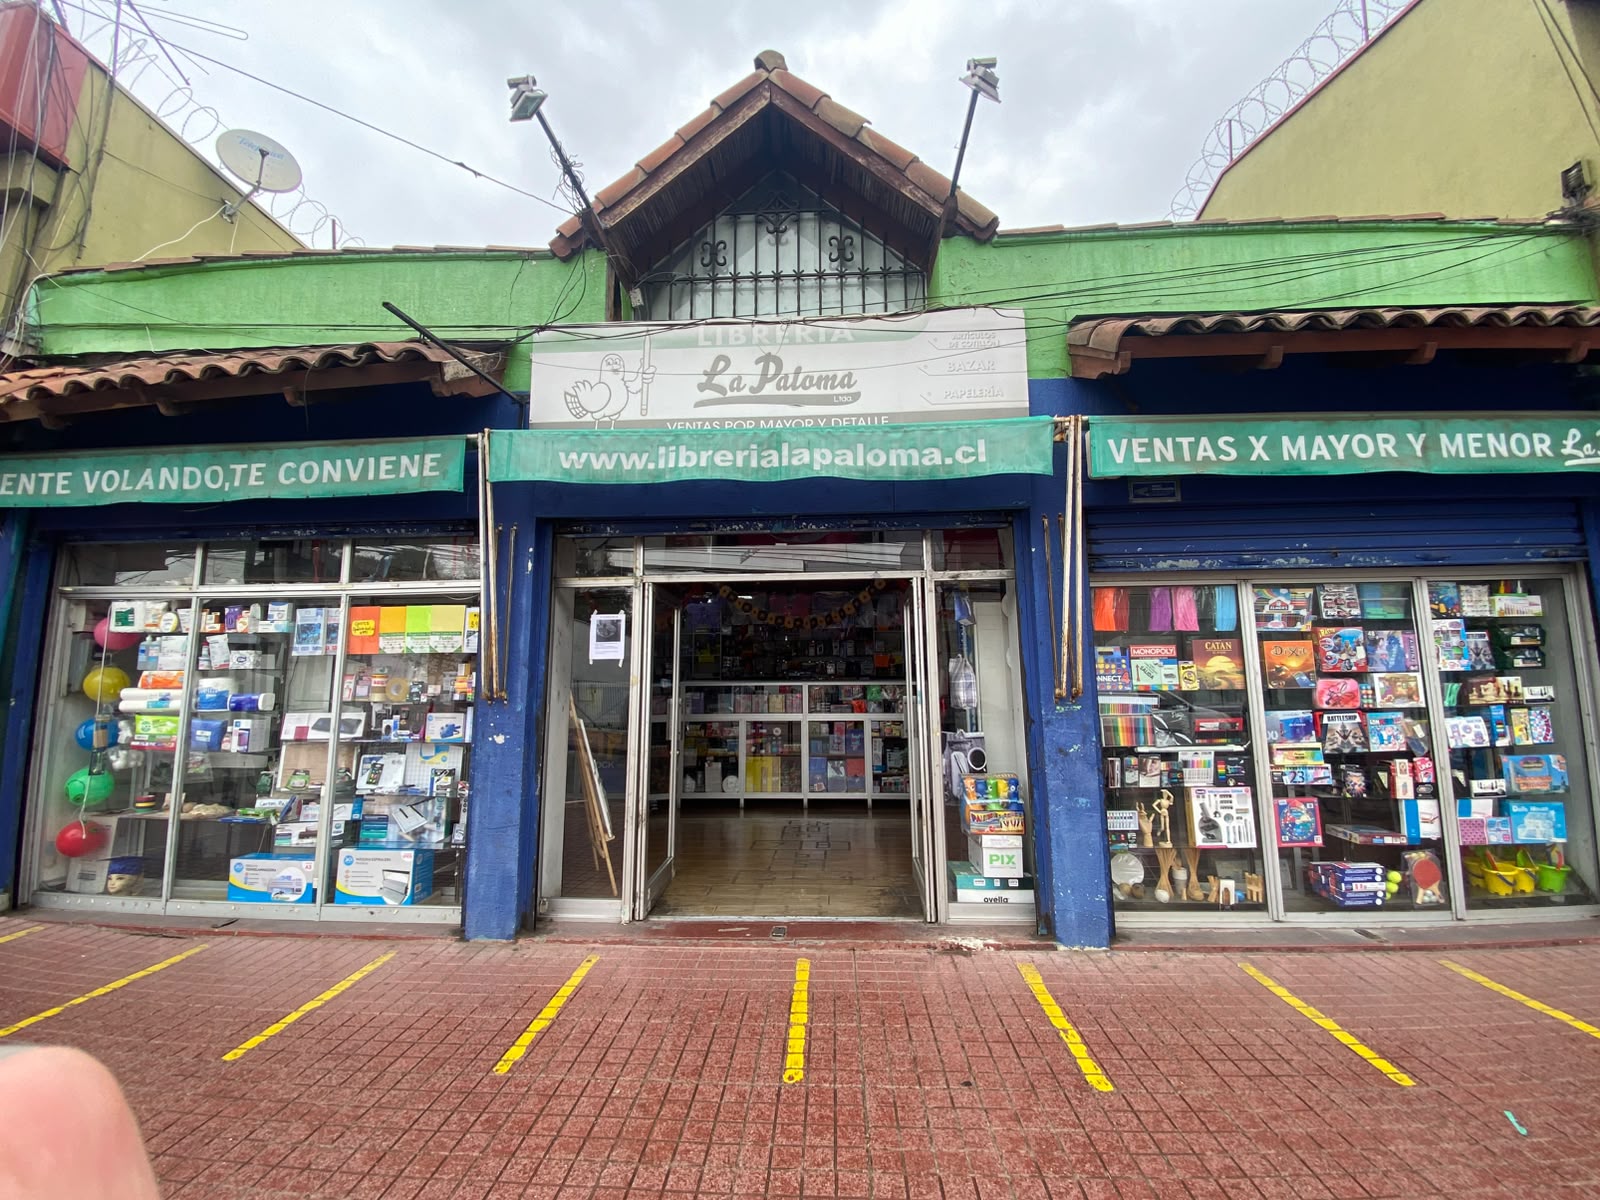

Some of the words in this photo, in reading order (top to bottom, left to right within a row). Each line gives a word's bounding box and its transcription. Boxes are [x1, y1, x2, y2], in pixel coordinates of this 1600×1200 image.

[947, 361, 996, 372] BAZAR
[697, 354, 746, 396] La
[750, 352, 858, 394] Paloma
[667, 421, 719, 429] VENTAS
[725, 420, 755, 429] POR
[761, 419, 813, 428] MAYOR
[818, 418, 827, 426] Y
[832, 415, 889, 426] DETALLE
[1107, 435, 1237, 464] VENTAS
[1248, 435, 1270, 461] X
[1282, 433, 1399, 461] MAYOR
[1406, 433, 1426, 457] Y
[1440, 432, 1554, 458] MENOR
[1561, 428, 1596, 458] La
[559, 439, 987, 471] www.librerialapaloma.cl
[0, 472, 72, 495] ENTE
[278, 453, 441, 485] CONVIENE
[1132, 647, 1175, 656] MONOPOLY
[1205, 641, 1232, 650] CATAN
[1121, 669, 1131, 685] 4
[1326, 714, 1358, 723] BATTLESHIP
[1289, 770, 1305, 784] 23
[989, 854, 1016, 865] PIX
